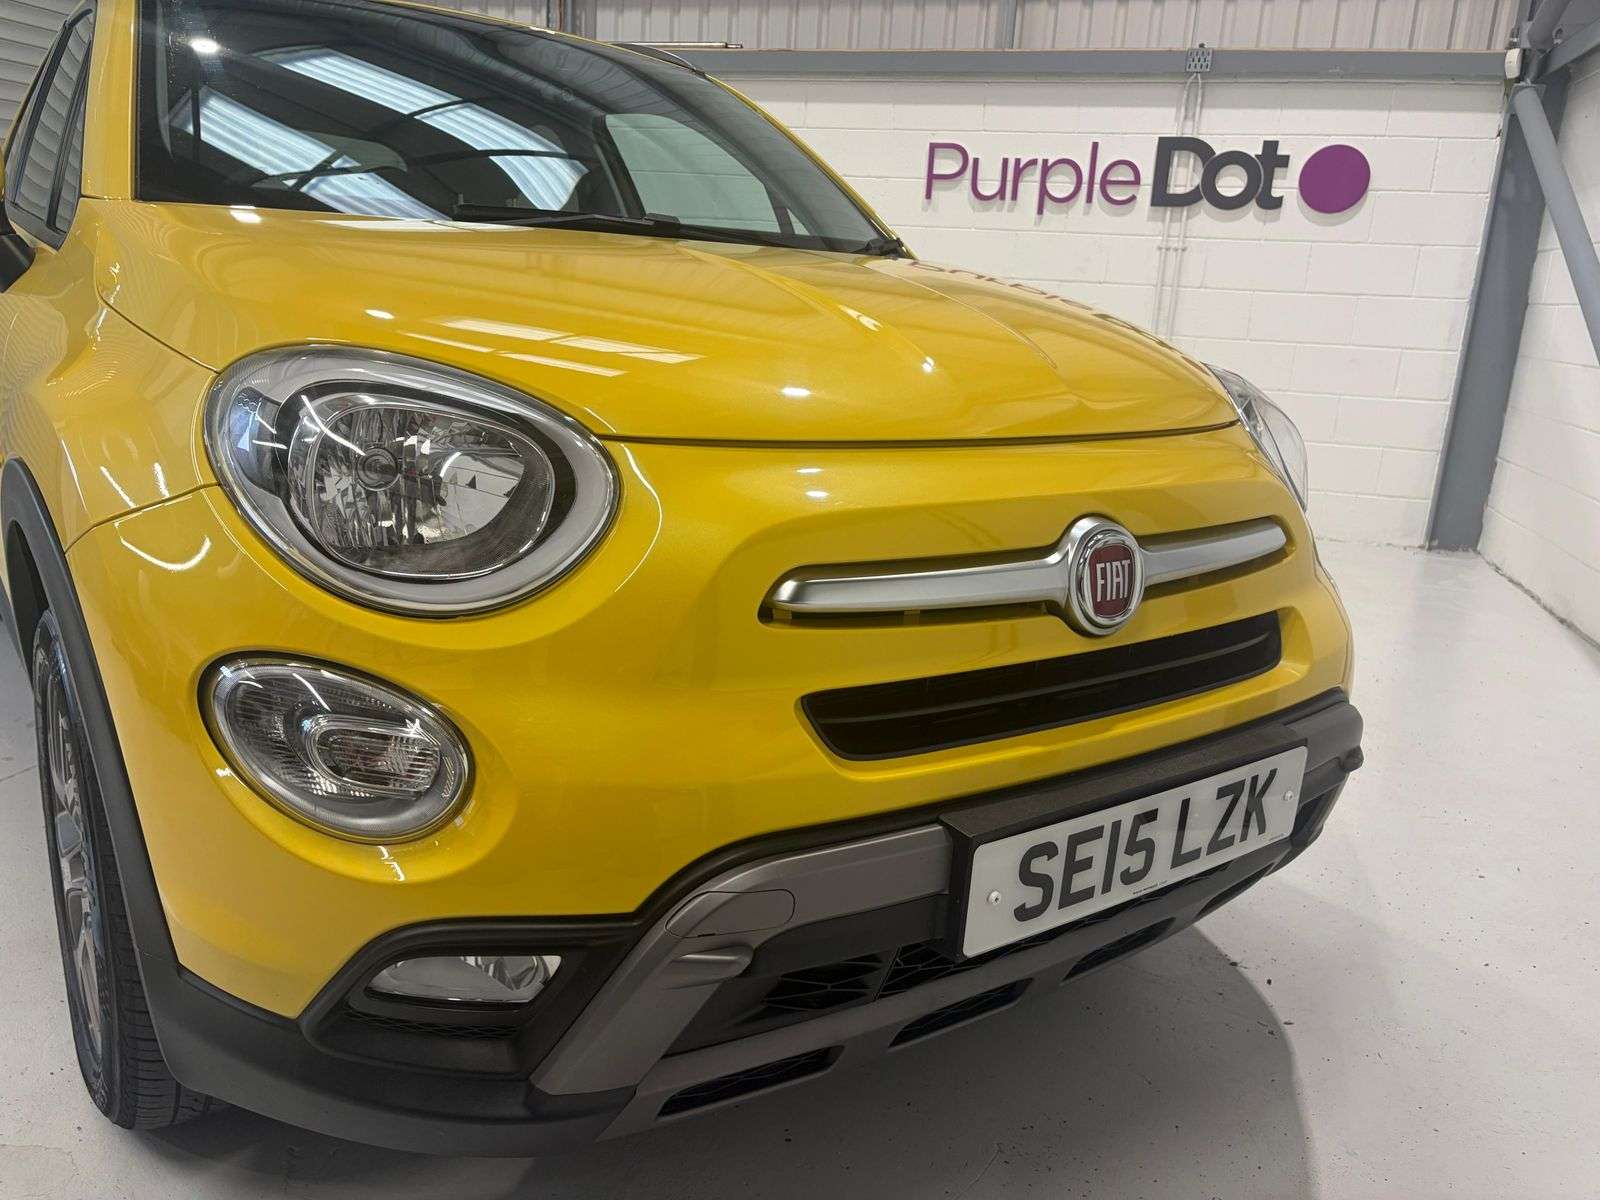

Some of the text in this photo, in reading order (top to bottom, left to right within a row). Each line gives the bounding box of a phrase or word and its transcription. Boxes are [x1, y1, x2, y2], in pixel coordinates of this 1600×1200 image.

[924, 136, 1290, 215] Purple Dot
[1096, 559, 1131, 602] FIAT
[1013, 767, 1278, 922] SE15 LZK
